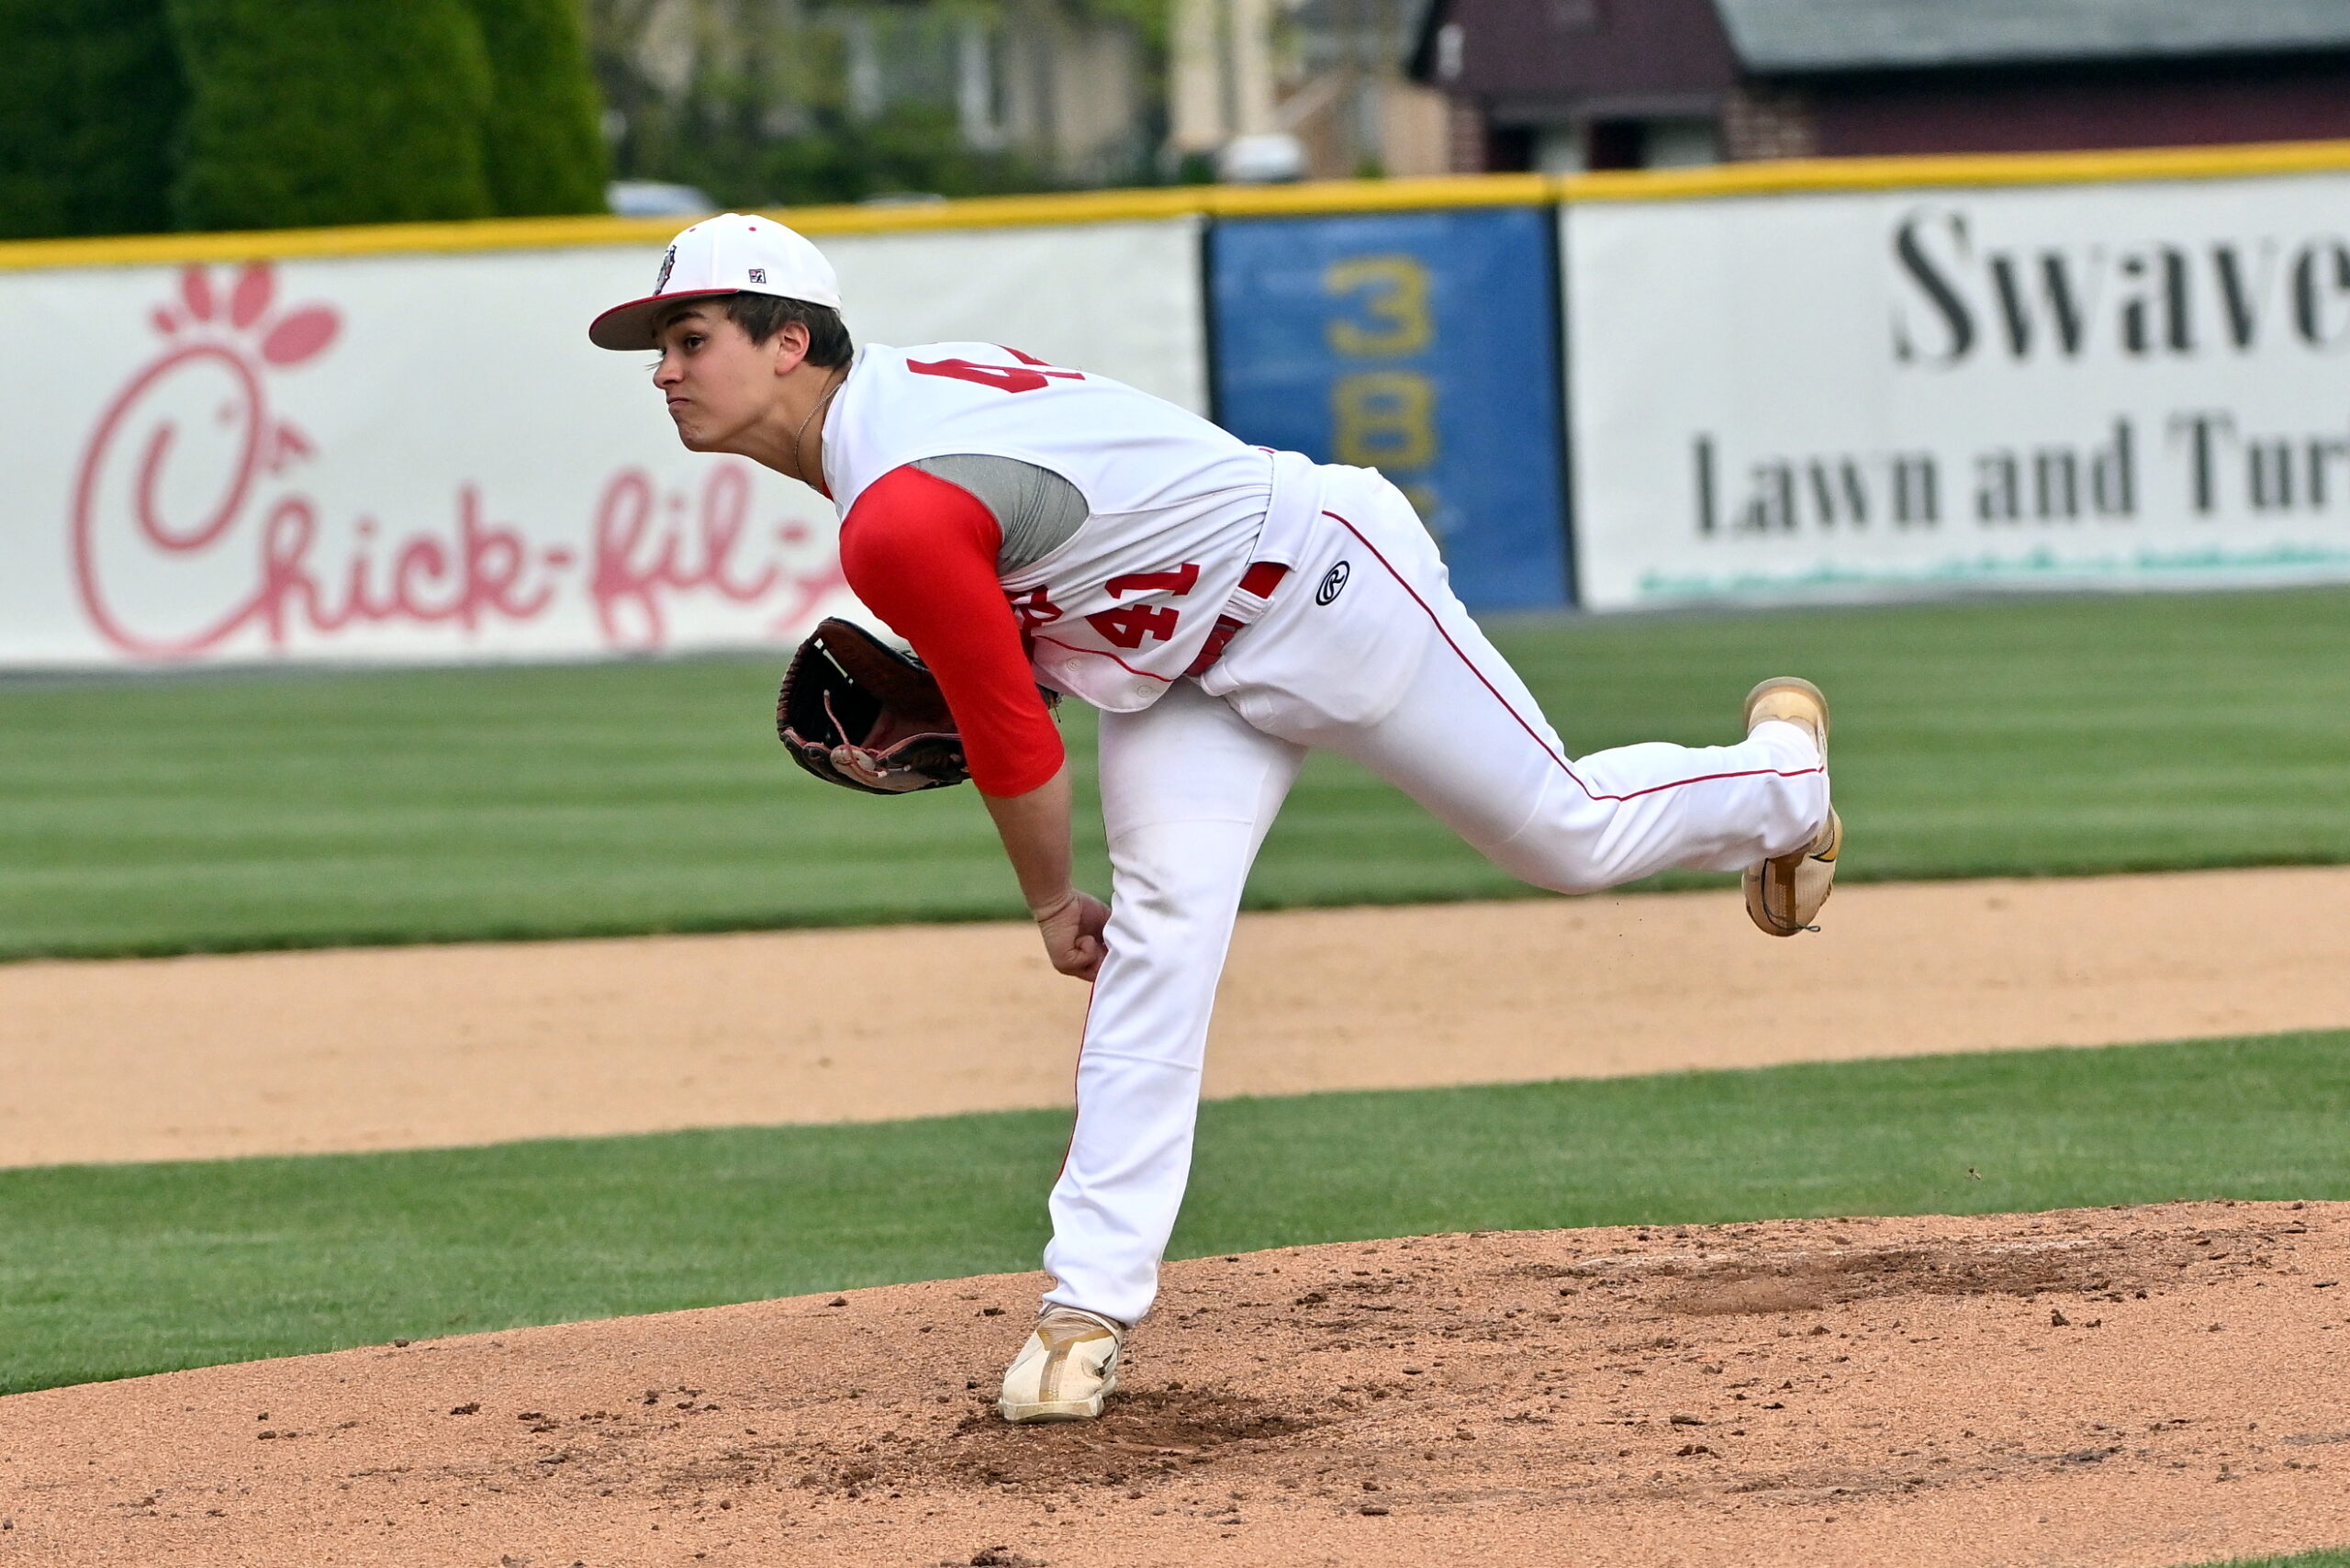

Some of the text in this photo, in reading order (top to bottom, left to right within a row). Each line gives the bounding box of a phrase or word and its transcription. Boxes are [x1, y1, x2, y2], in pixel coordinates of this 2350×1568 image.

[1891, 206, 2350, 367] Swave
[1692, 430, 1939, 538] Lawn
[1974, 416, 2139, 525] and
[1086, 563, 1199, 649] 41
